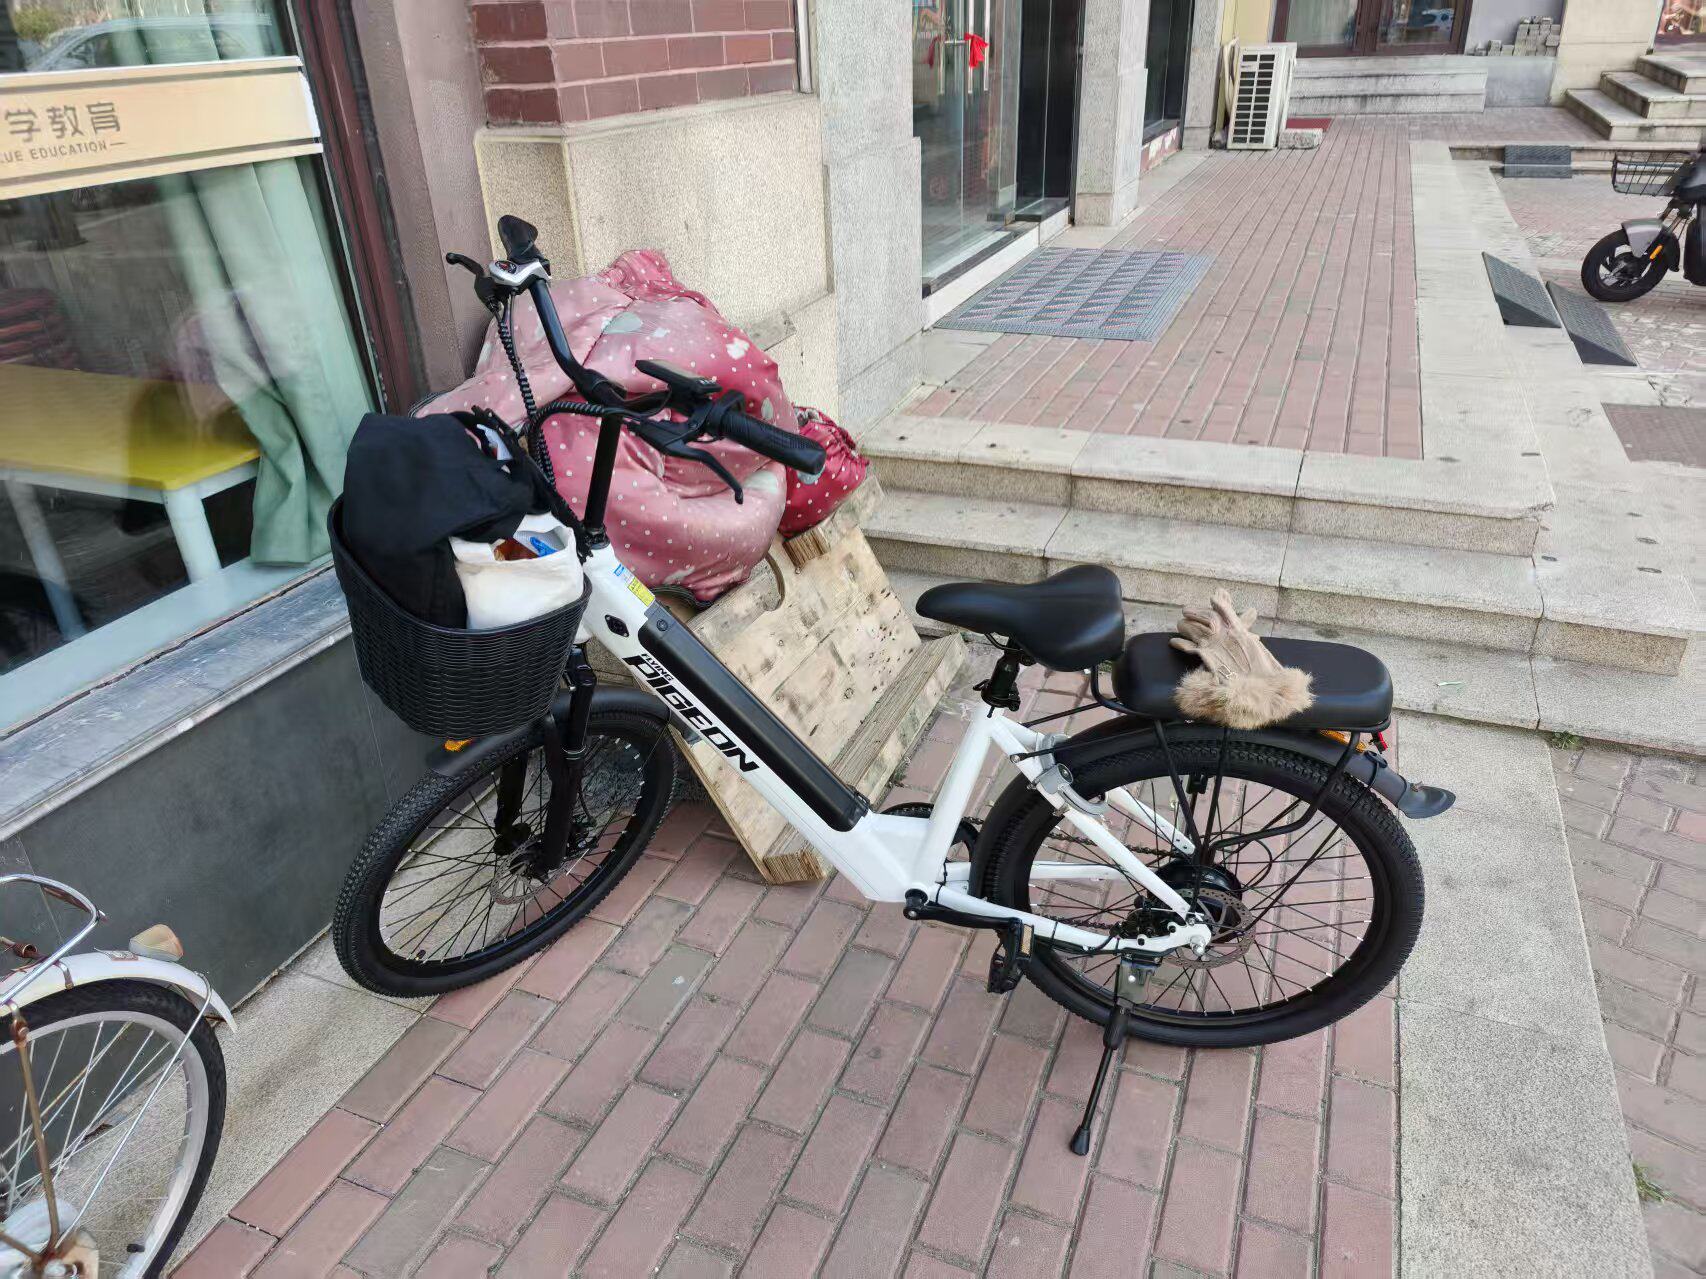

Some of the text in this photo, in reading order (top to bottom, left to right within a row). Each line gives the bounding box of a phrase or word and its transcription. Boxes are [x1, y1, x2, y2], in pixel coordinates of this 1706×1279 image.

[4, 101, 121, 143] 学教育
[29, 140, 108, 161] EDUCATION
[641, 653, 674, 681] FLYING
[622, 655, 760, 772] PIGEON
